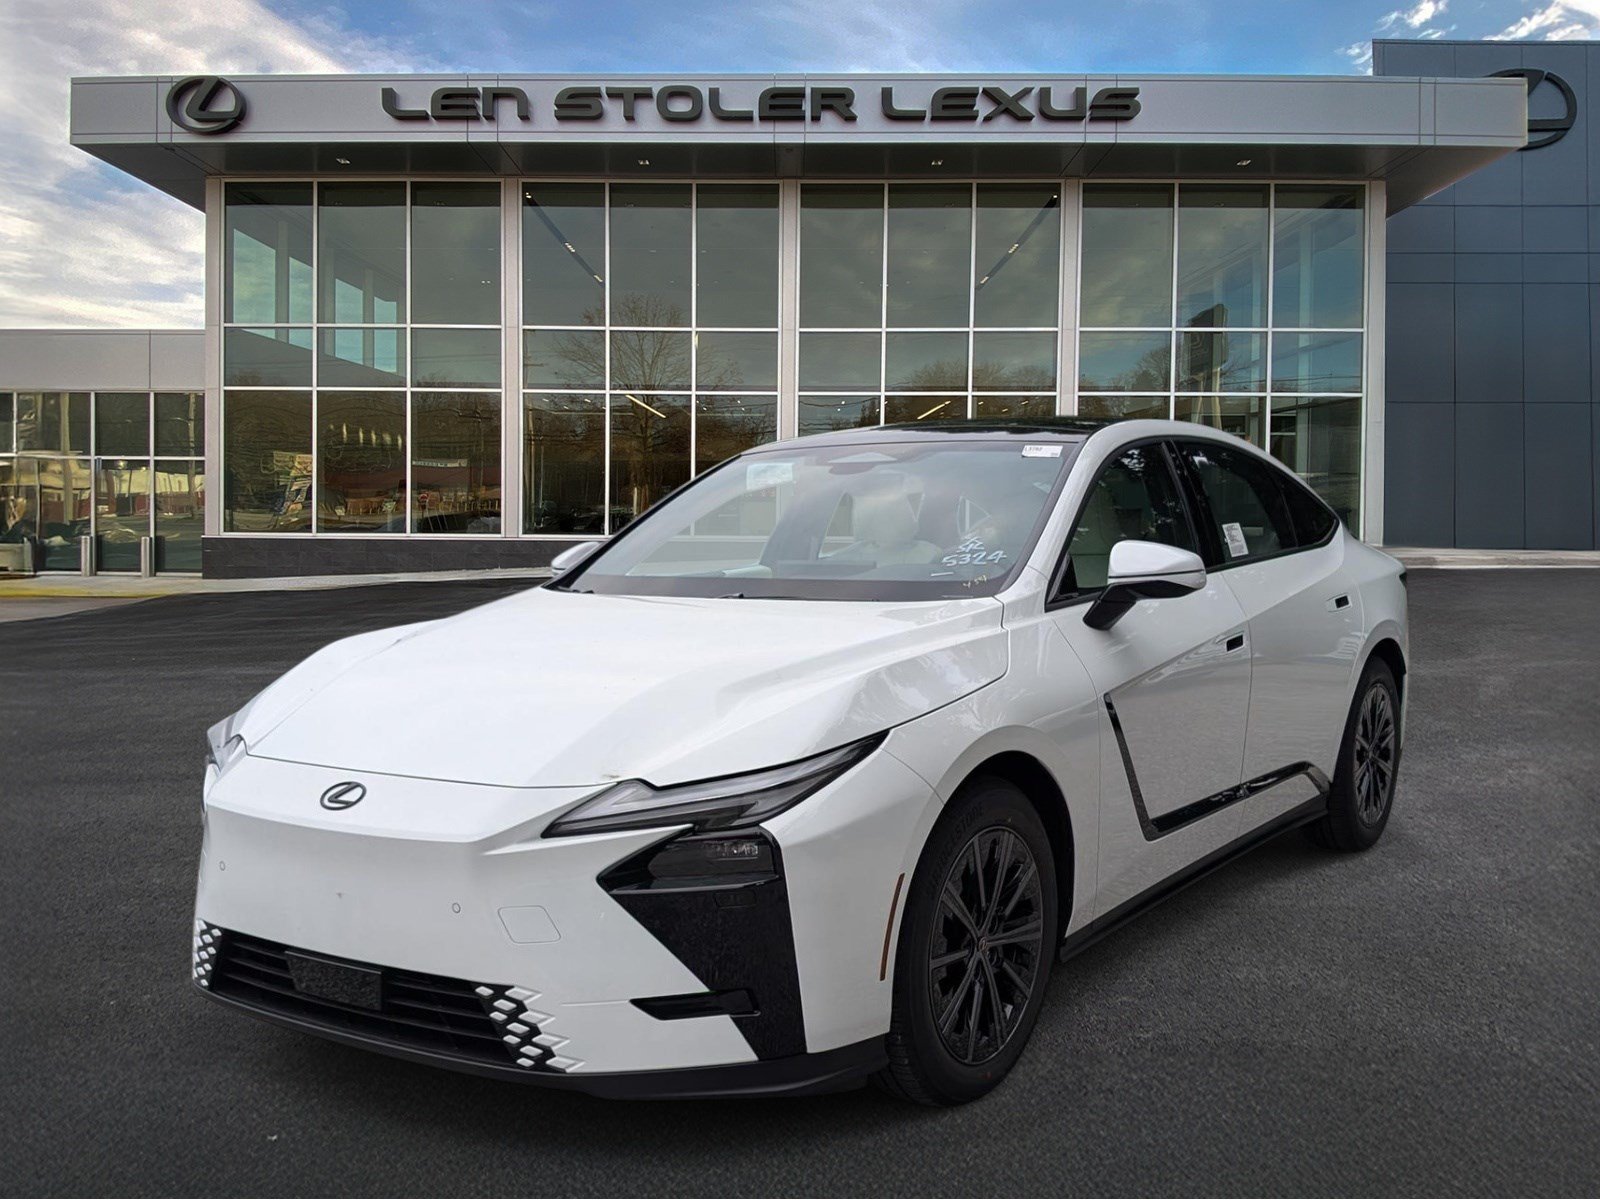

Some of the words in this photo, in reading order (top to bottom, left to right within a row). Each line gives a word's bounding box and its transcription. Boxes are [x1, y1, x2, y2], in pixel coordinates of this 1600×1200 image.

[381, 86, 530, 122] LEN
[553, 86, 857, 122] STOLER
[881, 86, 1141, 122] LEXUS
